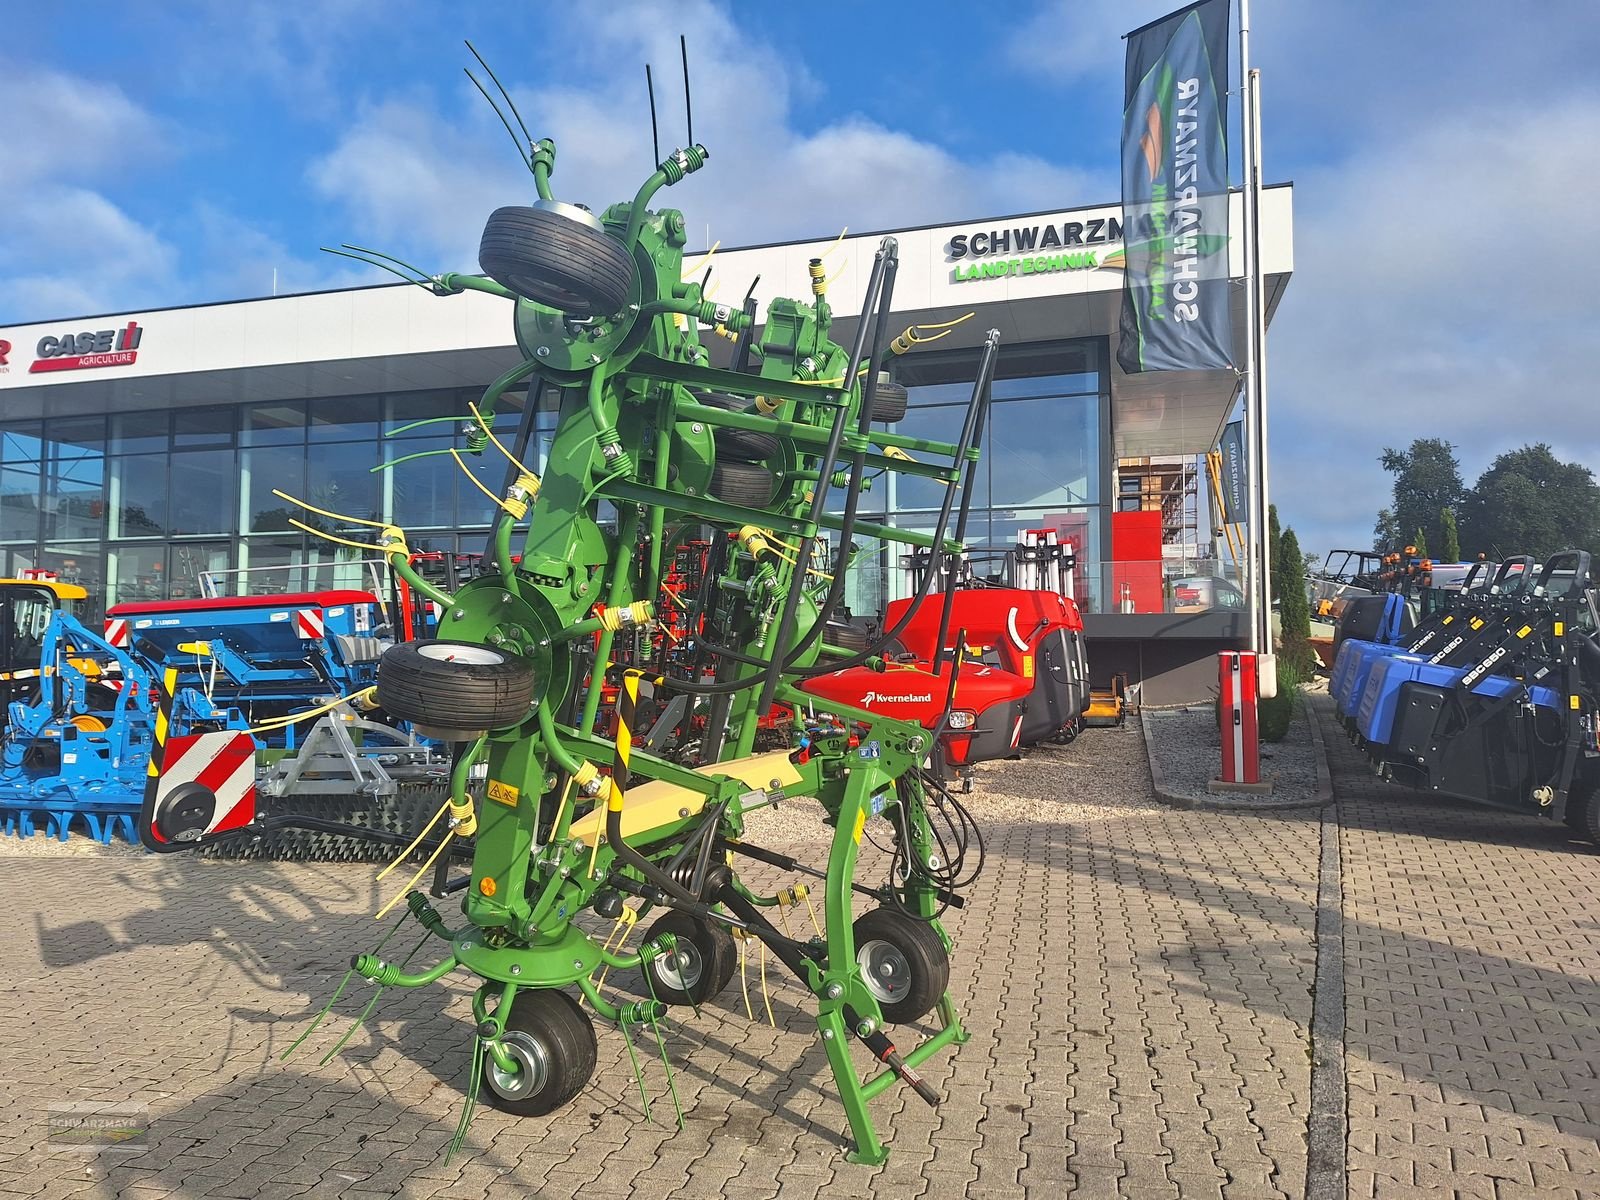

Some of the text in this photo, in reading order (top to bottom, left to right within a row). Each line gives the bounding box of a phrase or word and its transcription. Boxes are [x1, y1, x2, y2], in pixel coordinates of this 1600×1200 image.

[950, 209, 1203, 258] SCHWARZM
[954, 250, 1099, 282] LANDTECHNIK
[36, 330, 115, 358] CASE
[79, 353, 132, 365] AGRICULTURE
[876, 693, 932, 703] Kverneland
